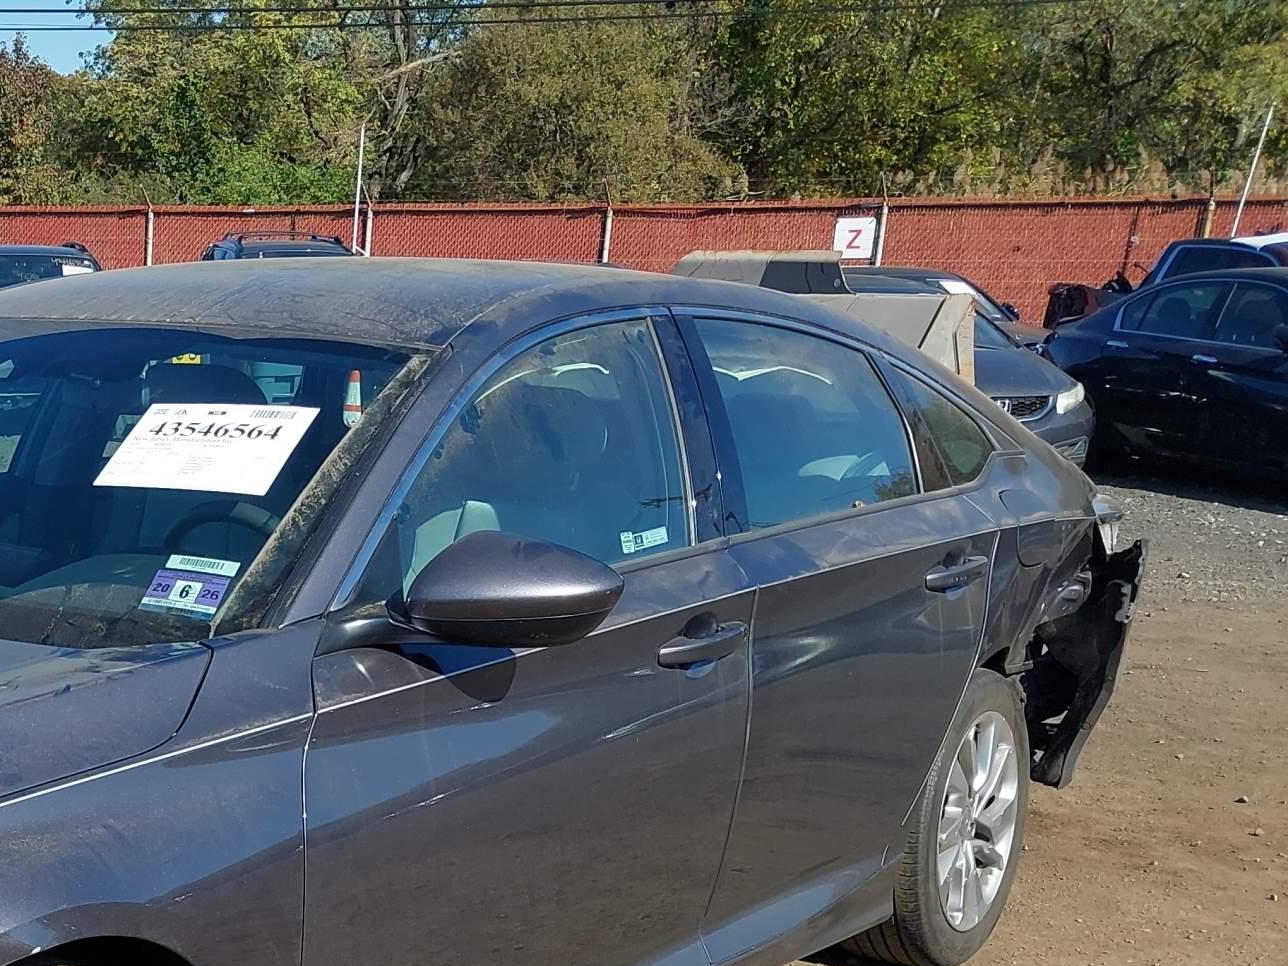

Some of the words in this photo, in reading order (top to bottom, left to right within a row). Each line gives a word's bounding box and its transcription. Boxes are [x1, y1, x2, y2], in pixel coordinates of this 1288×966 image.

[846, 229, 863, 249] Z
[149, 421, 284, 440] 43546564
[152, 583, 171, 593] 20
[179, 584, 192, 599] 6
[201, 589, 219, 600] 26
